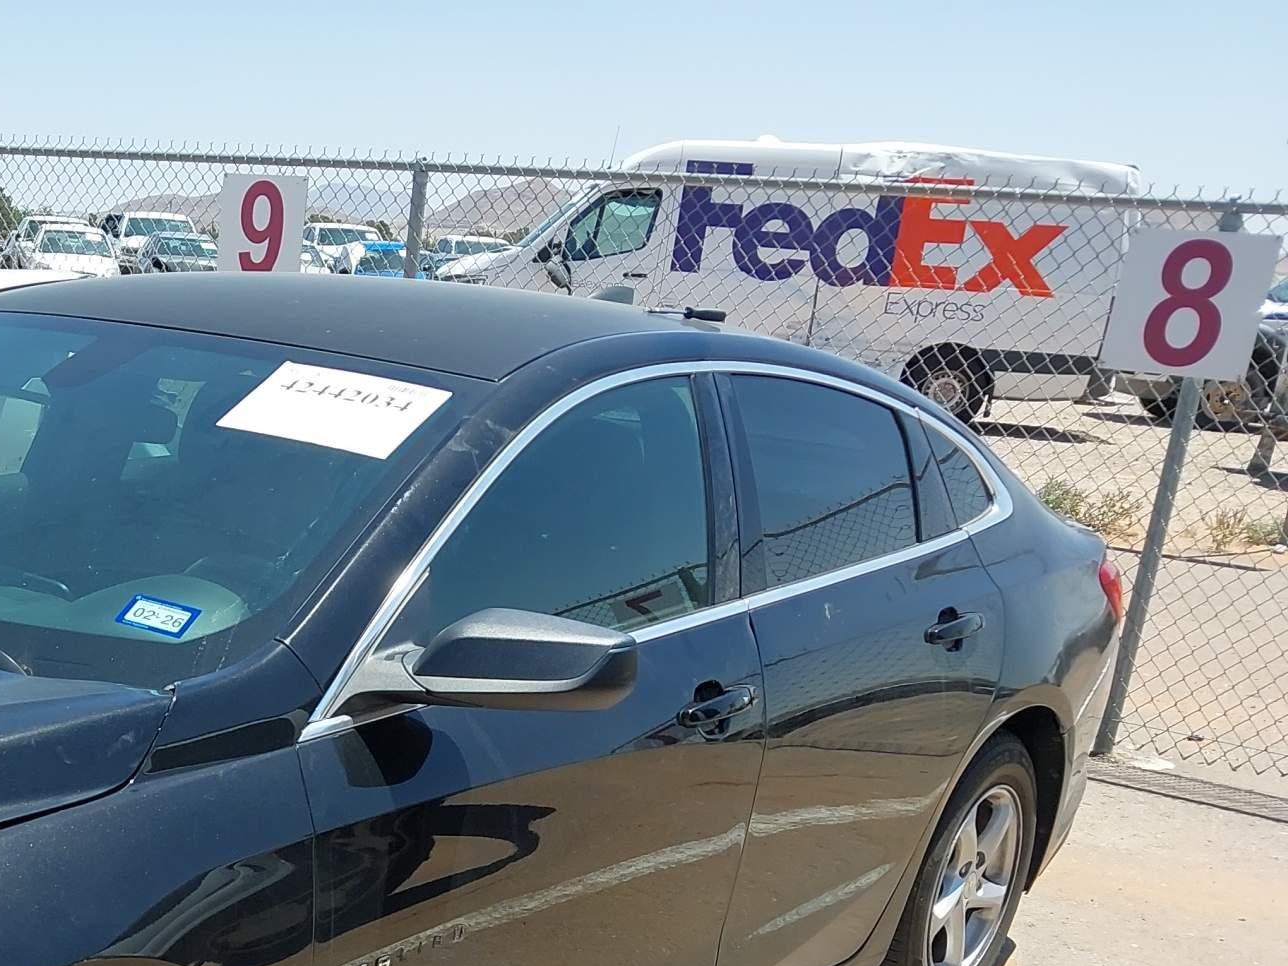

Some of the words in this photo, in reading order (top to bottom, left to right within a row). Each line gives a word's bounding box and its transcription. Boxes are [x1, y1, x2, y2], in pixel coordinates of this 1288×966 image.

[238, 179, 284, 272] 9
[670, 159, 1069, 299] FedEx
[884, 292, 987, 323] Express
[1143, 238, 1234, 368] 8
[280, 379, 413, 412] 42442034
